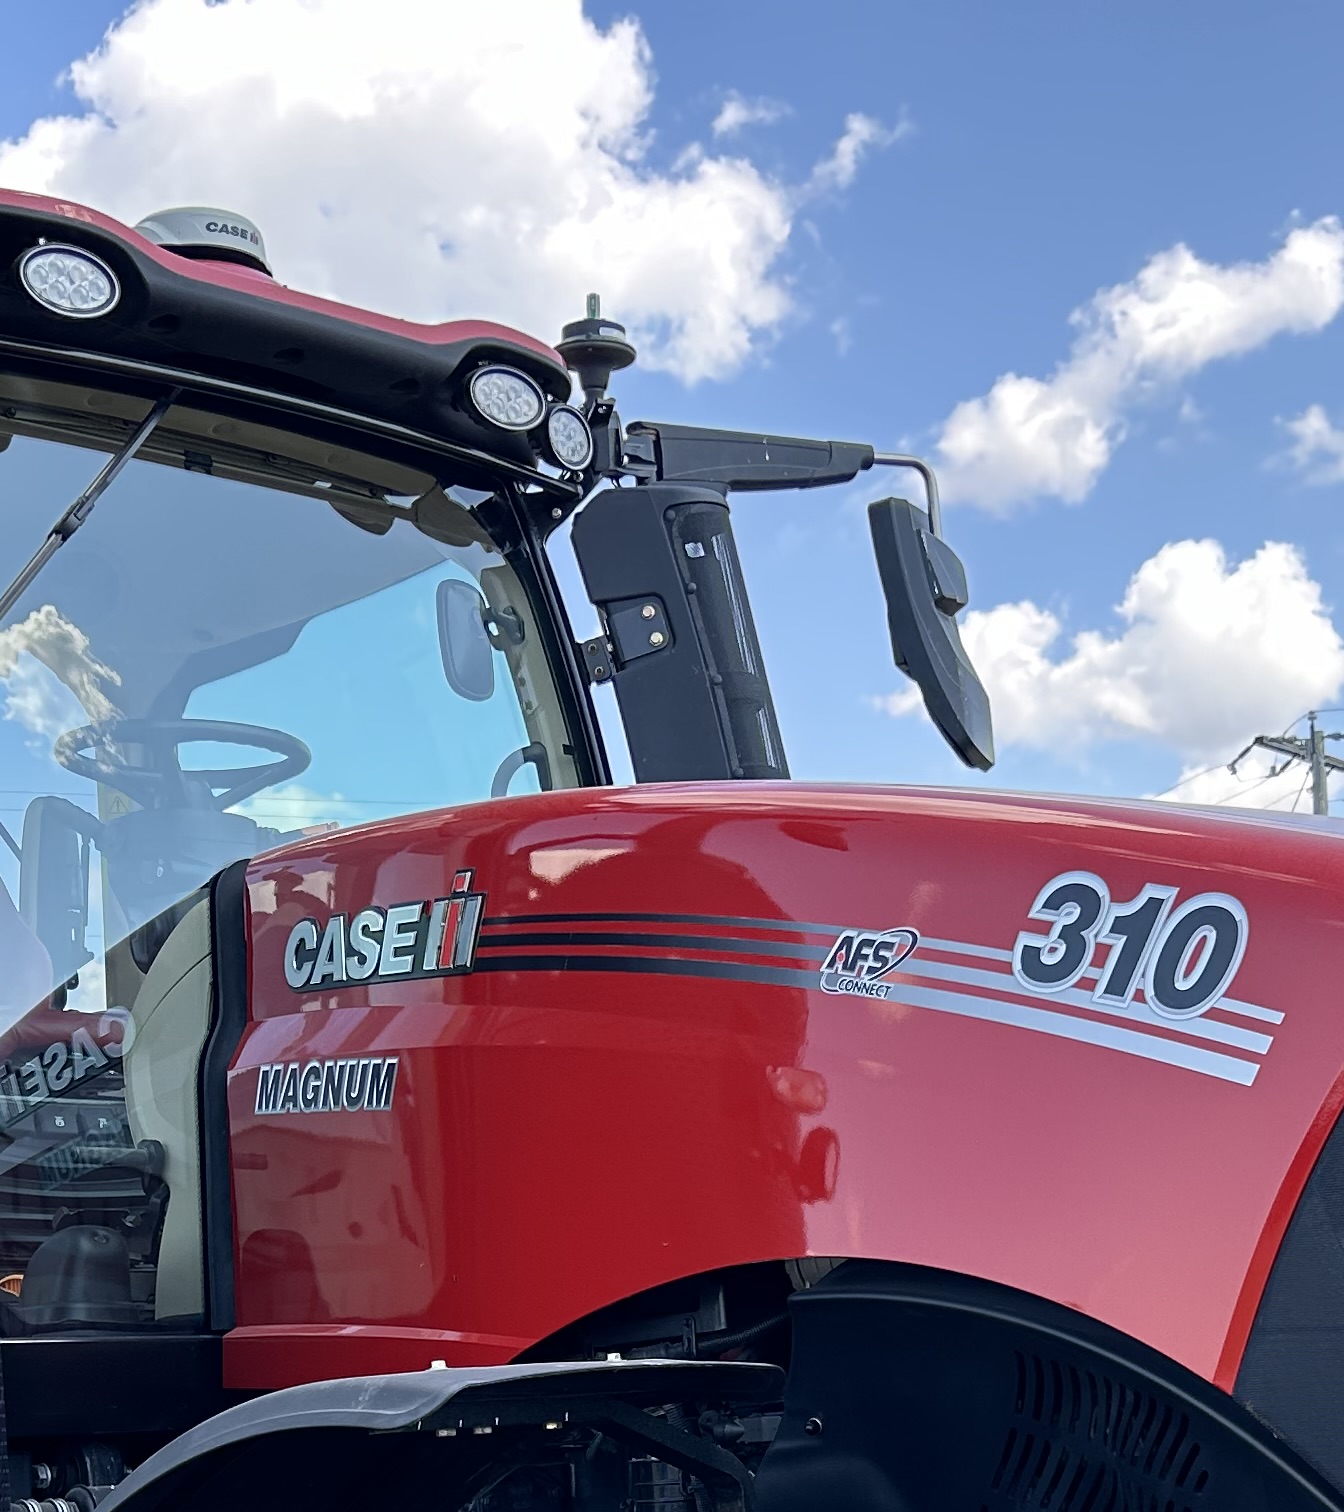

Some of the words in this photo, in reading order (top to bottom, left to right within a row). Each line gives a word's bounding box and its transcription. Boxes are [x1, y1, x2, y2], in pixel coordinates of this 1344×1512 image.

[205, 221, 248, 240] CASE
[284, 903, 424, 988] CASE
[819, 928, 901, 977] AFS
[1012, 870, 1249, 1020] 310
[836, 977, 893, 998] CONNECT
[255, 1056, 399, 1115] MAGNUM
